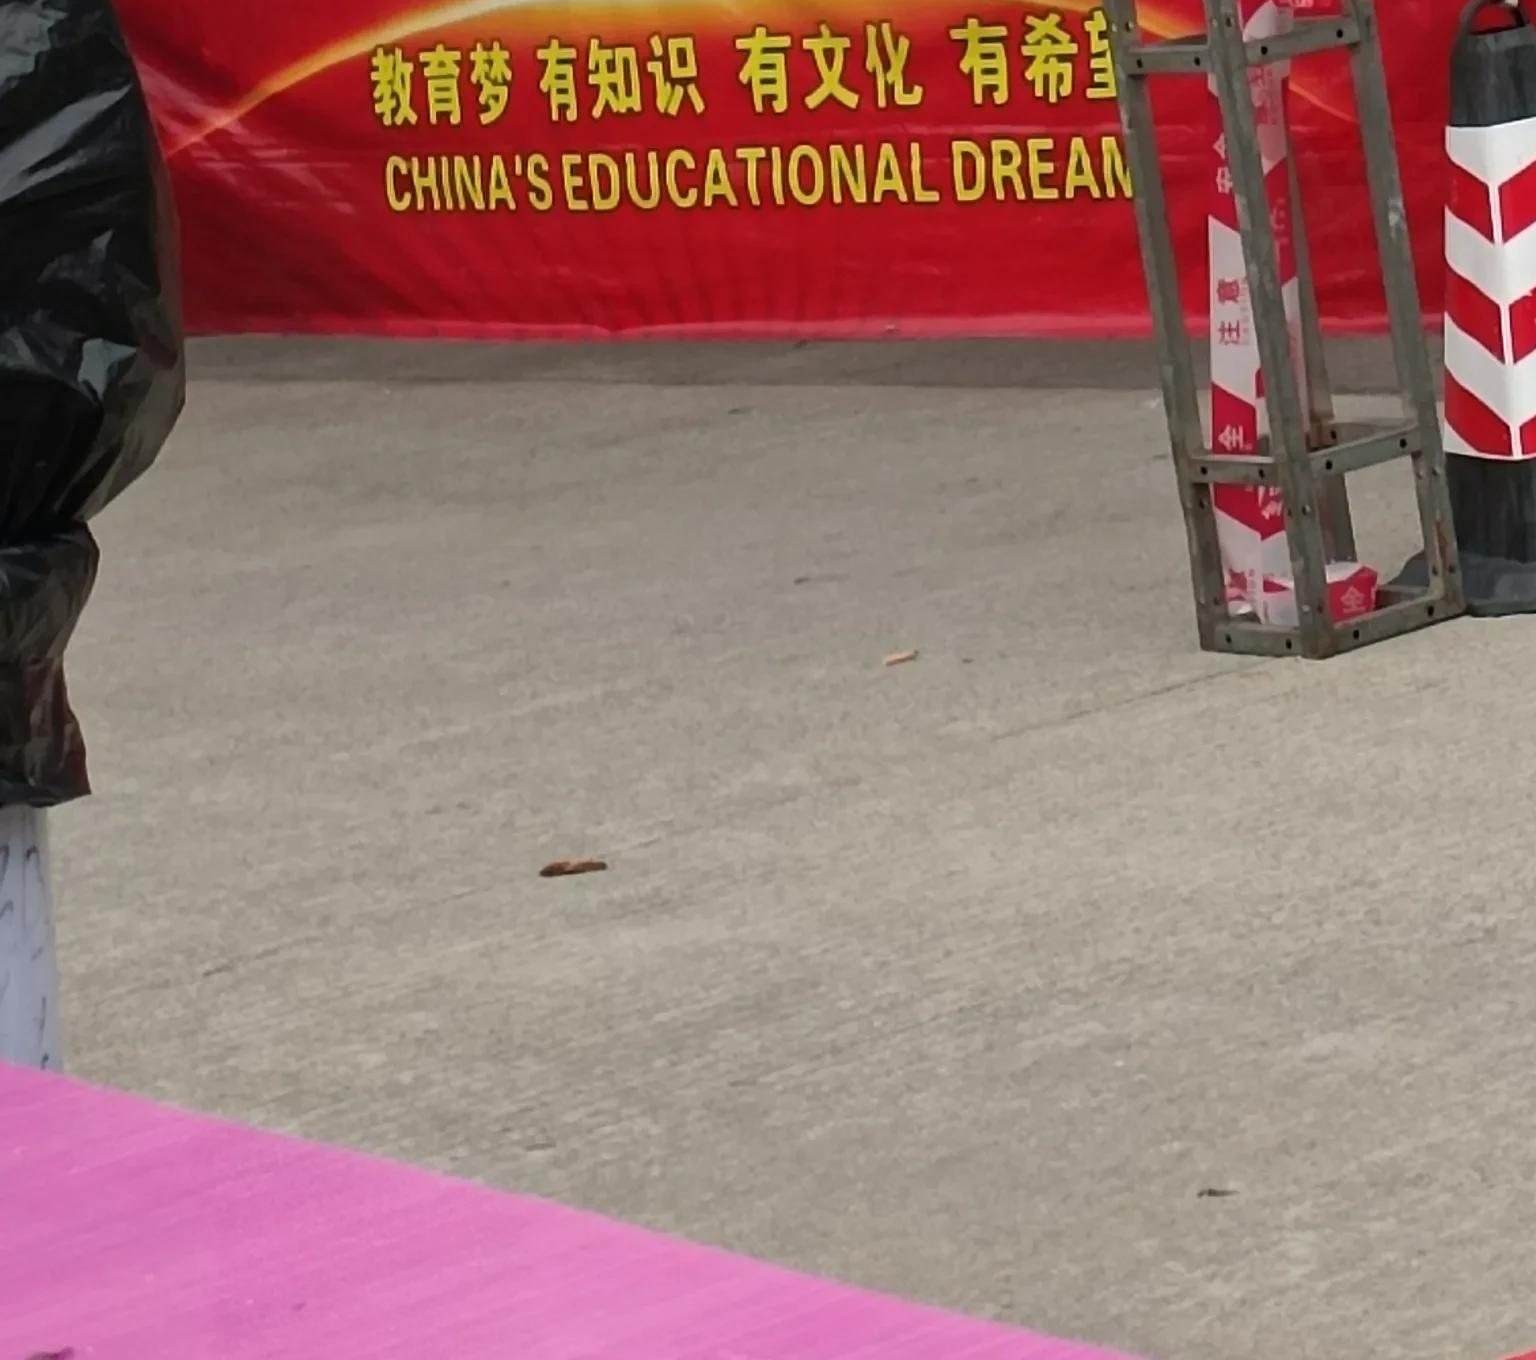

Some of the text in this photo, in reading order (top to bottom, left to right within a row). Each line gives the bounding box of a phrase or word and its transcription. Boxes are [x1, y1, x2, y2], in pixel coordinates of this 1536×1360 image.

[369, 39, 513, 126] 教育梦
[536, 35, 706, 123] 有知识
[734, 21, 924, 114] 有文化
[384, 152, 554, 214] CHINA'S
[561, 142, 941, 212] EDUCATIONAL
